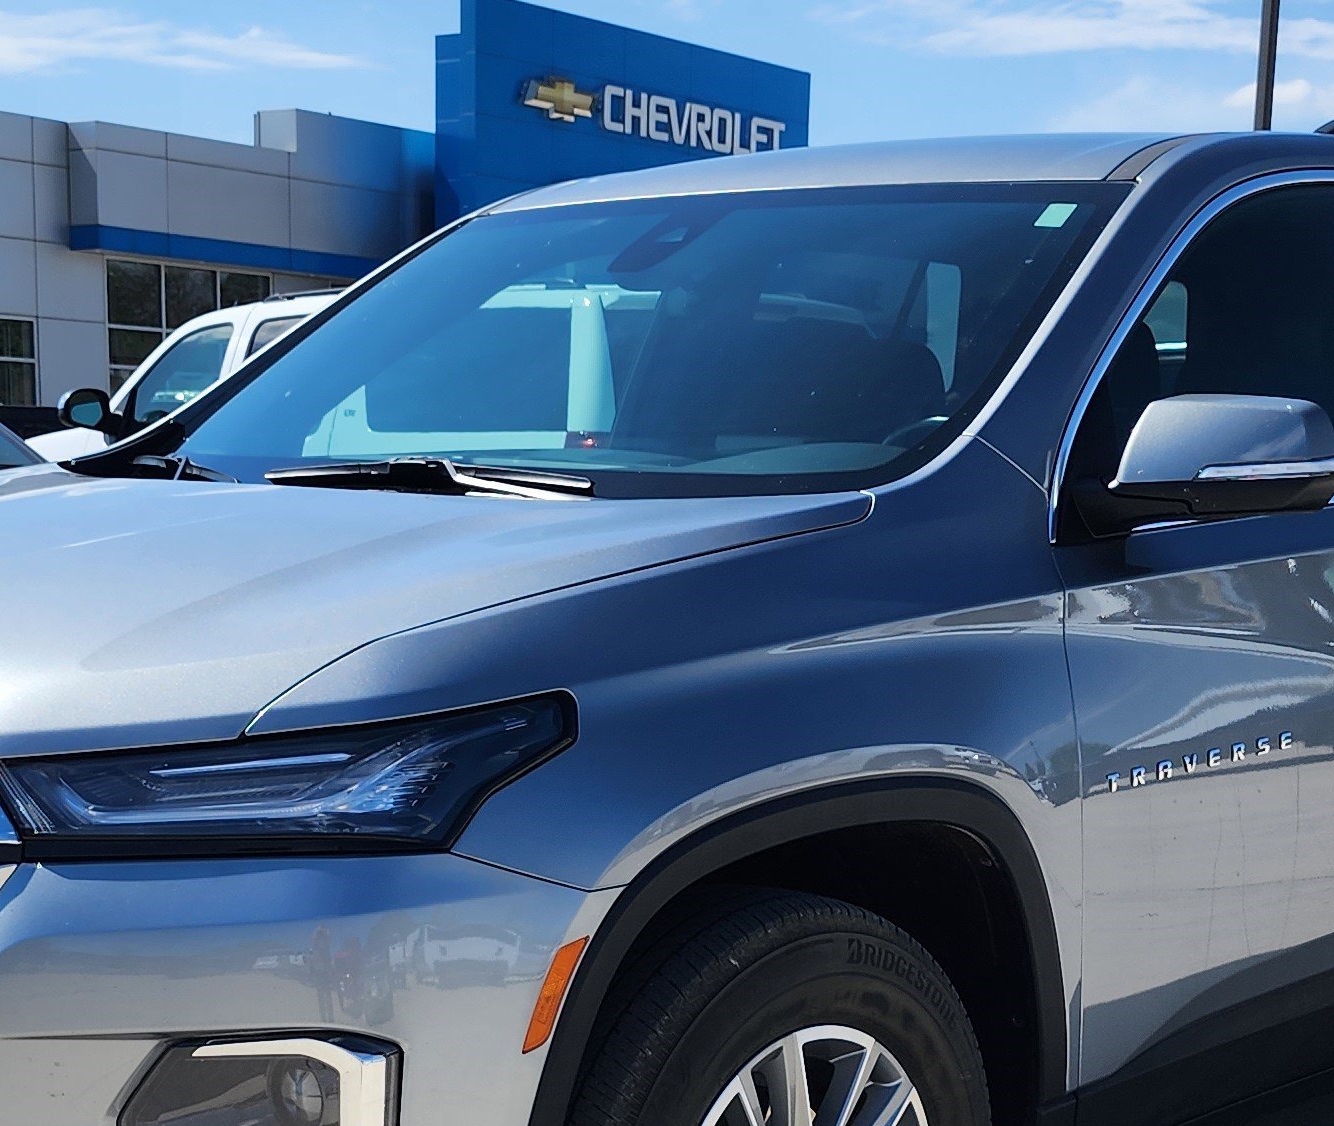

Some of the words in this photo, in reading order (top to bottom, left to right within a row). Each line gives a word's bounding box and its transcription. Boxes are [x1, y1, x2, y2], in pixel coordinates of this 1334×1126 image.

[603, 84, 786, 156] CHEVROLET
[1105, 731, 1293, 793] TRAVERSE
[846, 937, 957, 1032] BRIDGESTONE
